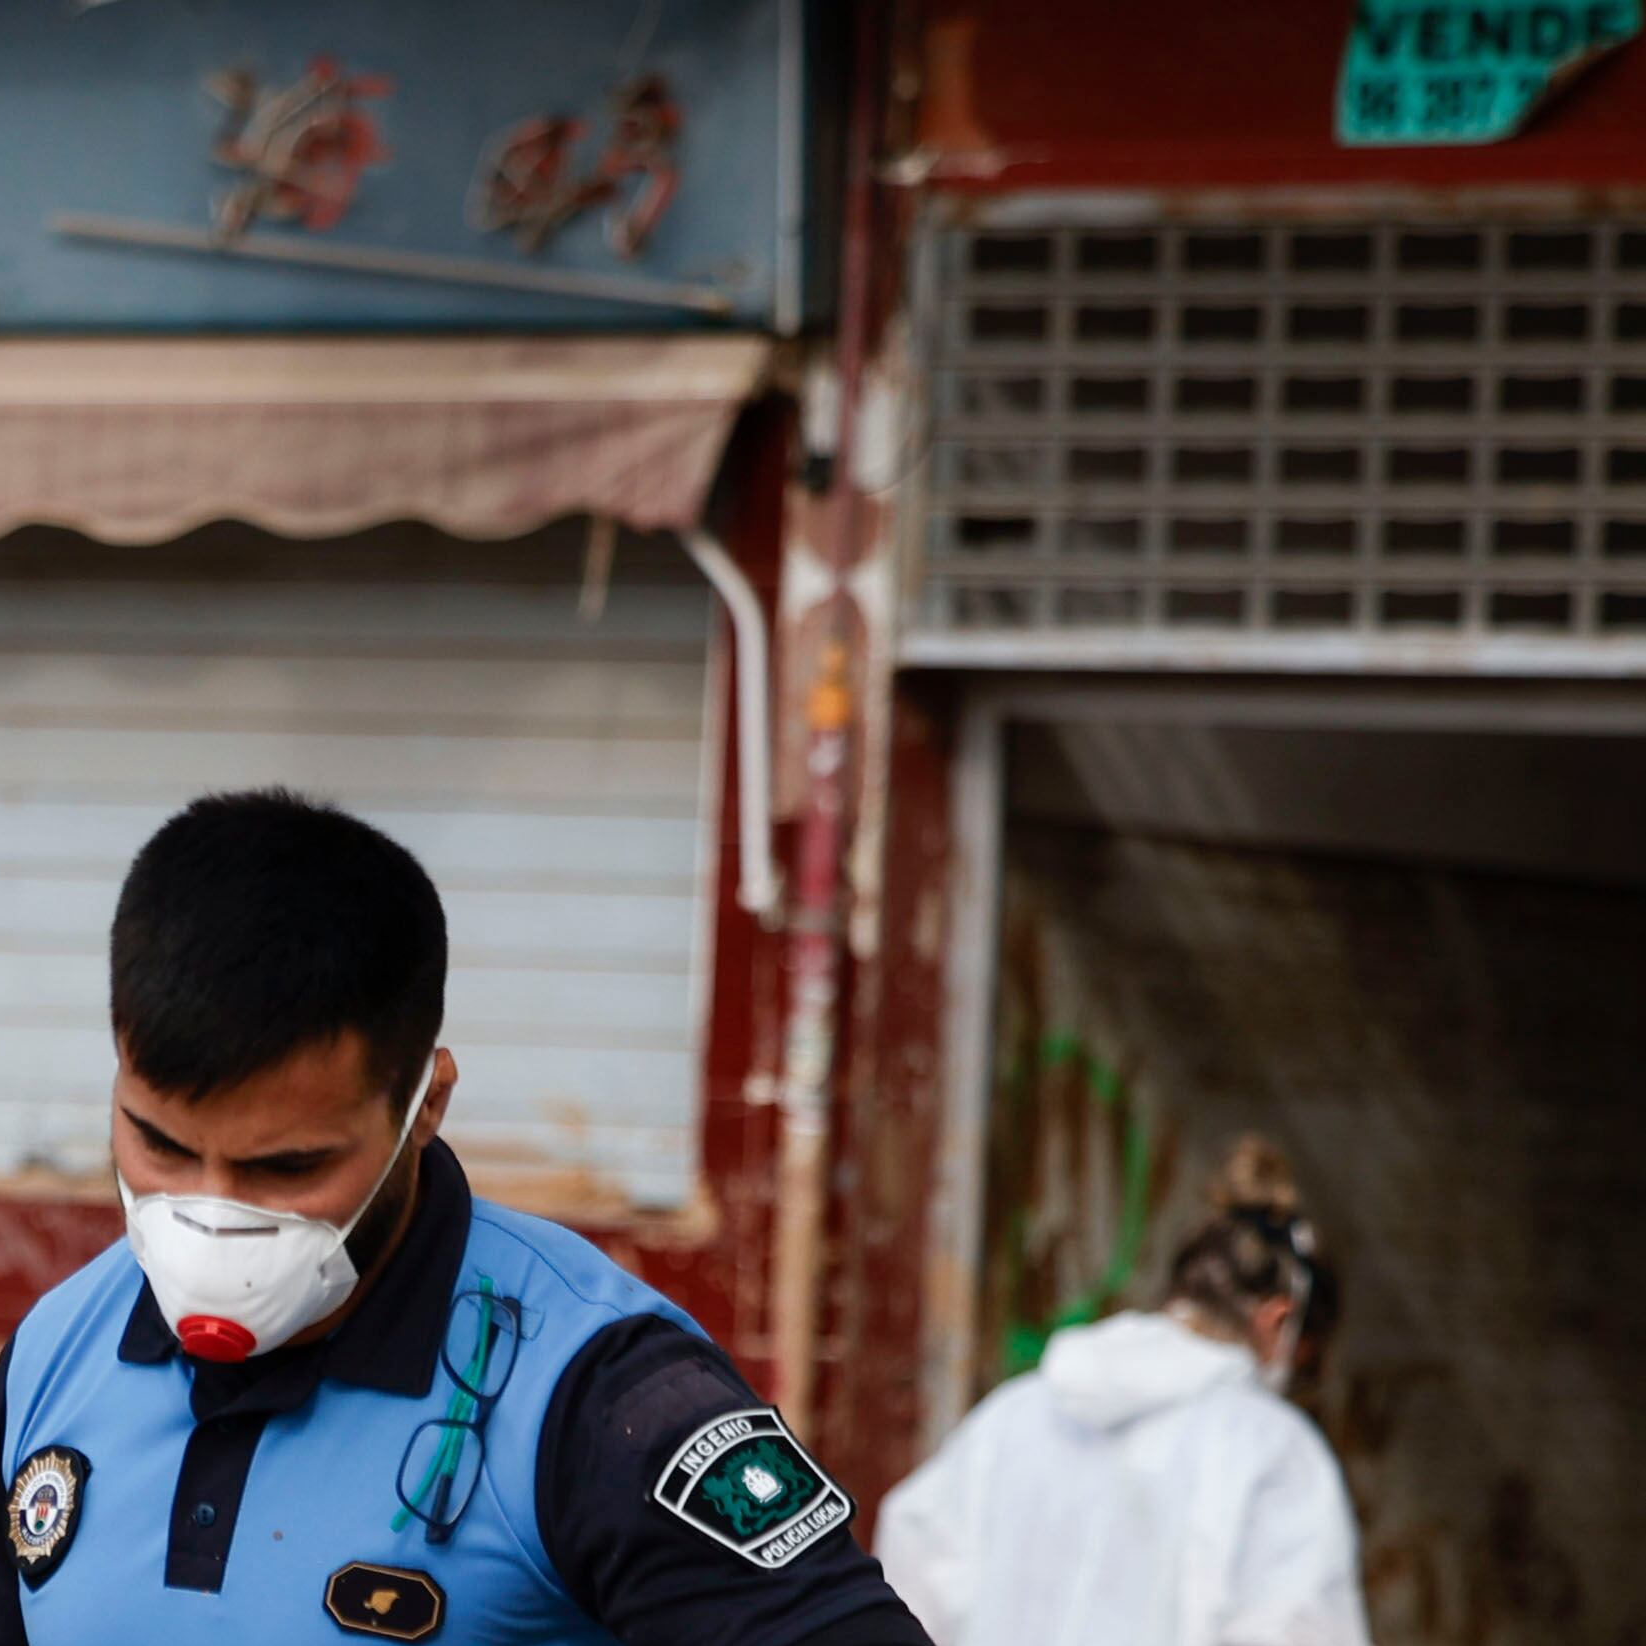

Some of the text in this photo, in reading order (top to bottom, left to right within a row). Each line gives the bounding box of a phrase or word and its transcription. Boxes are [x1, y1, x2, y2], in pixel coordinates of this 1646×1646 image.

[678, 1418, 753, 1476] INGENIO
[761, 1502, 844, 1564] POLICIA LOCAL
